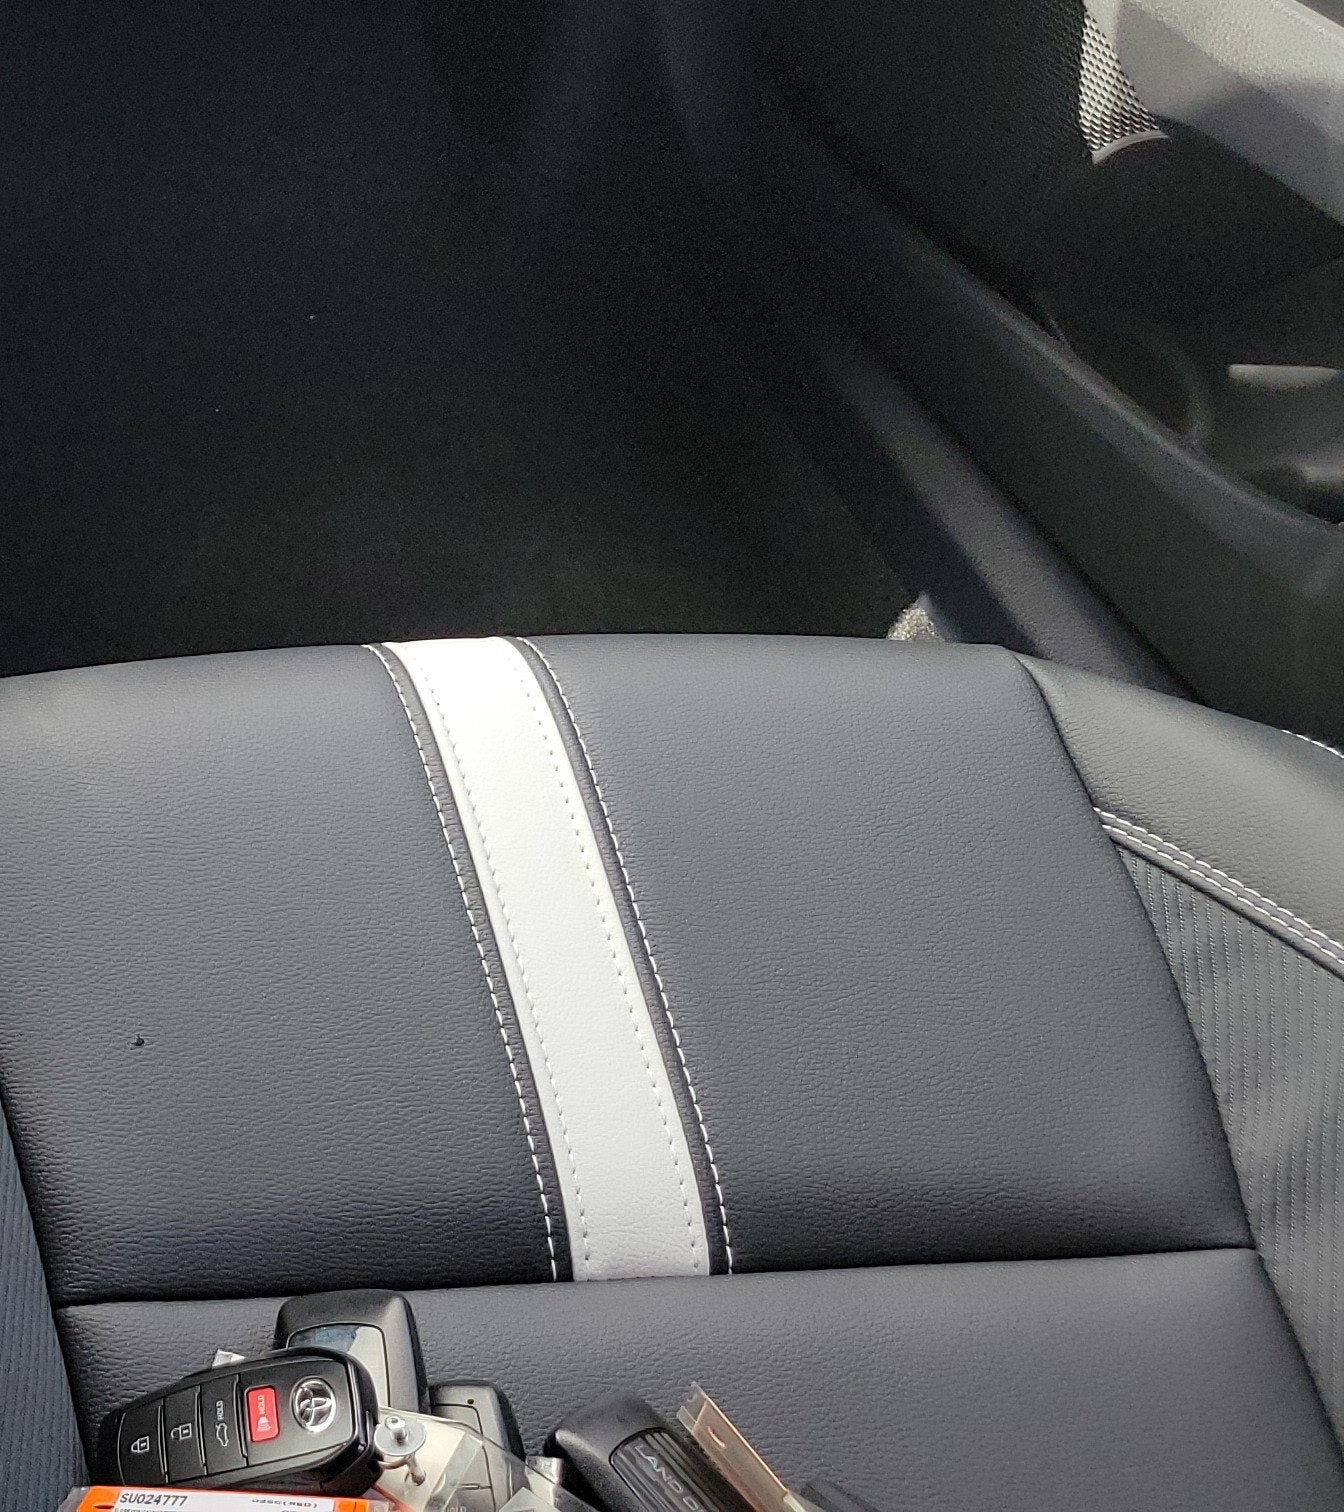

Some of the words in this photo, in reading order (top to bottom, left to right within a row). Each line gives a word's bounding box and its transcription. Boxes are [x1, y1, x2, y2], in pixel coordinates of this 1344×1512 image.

[216, 1400, 224, 1421] HOLD
[634, 1443, 683, 1493] LAND
[120, 1493, 188, 1506] SU024777
